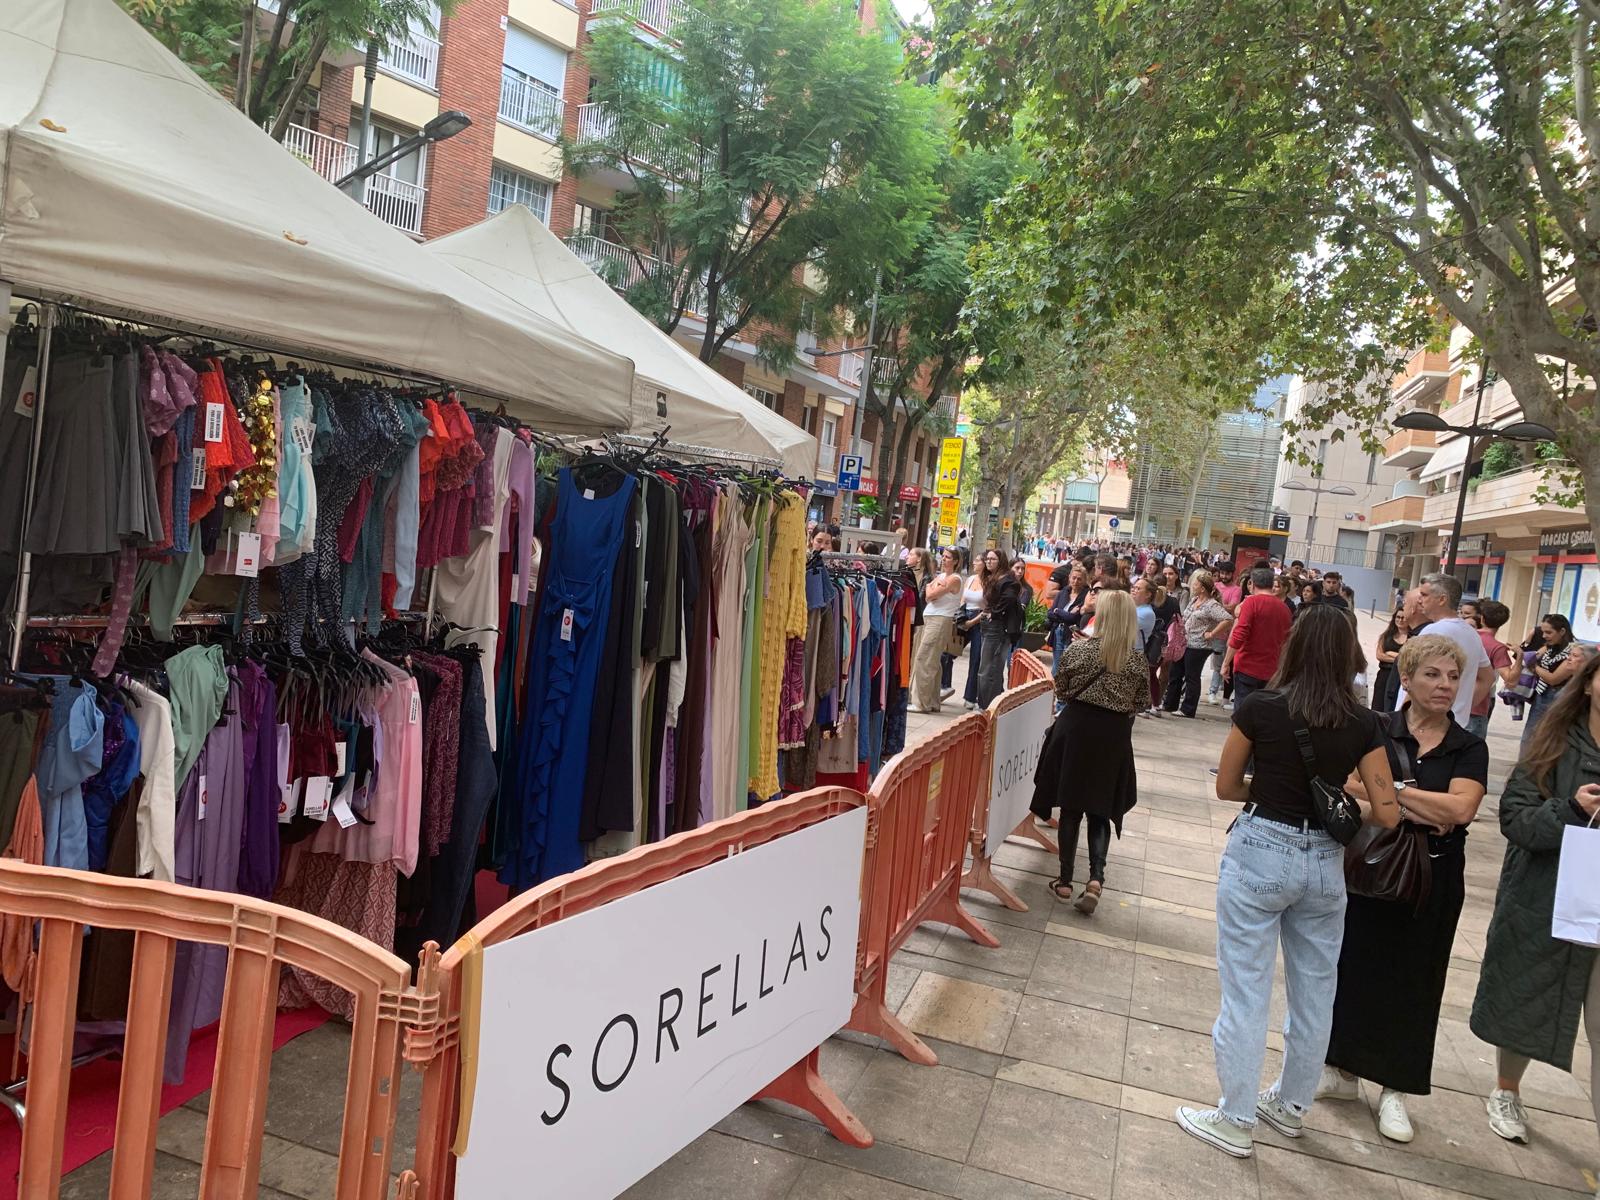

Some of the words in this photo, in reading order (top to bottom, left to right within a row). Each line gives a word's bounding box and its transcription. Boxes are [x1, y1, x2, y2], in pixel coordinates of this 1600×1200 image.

[845, 458, 856, 471] P
[997, 735, 1045, 798] SORELLA
[540, 905, 833, 1126] SORELLAS
